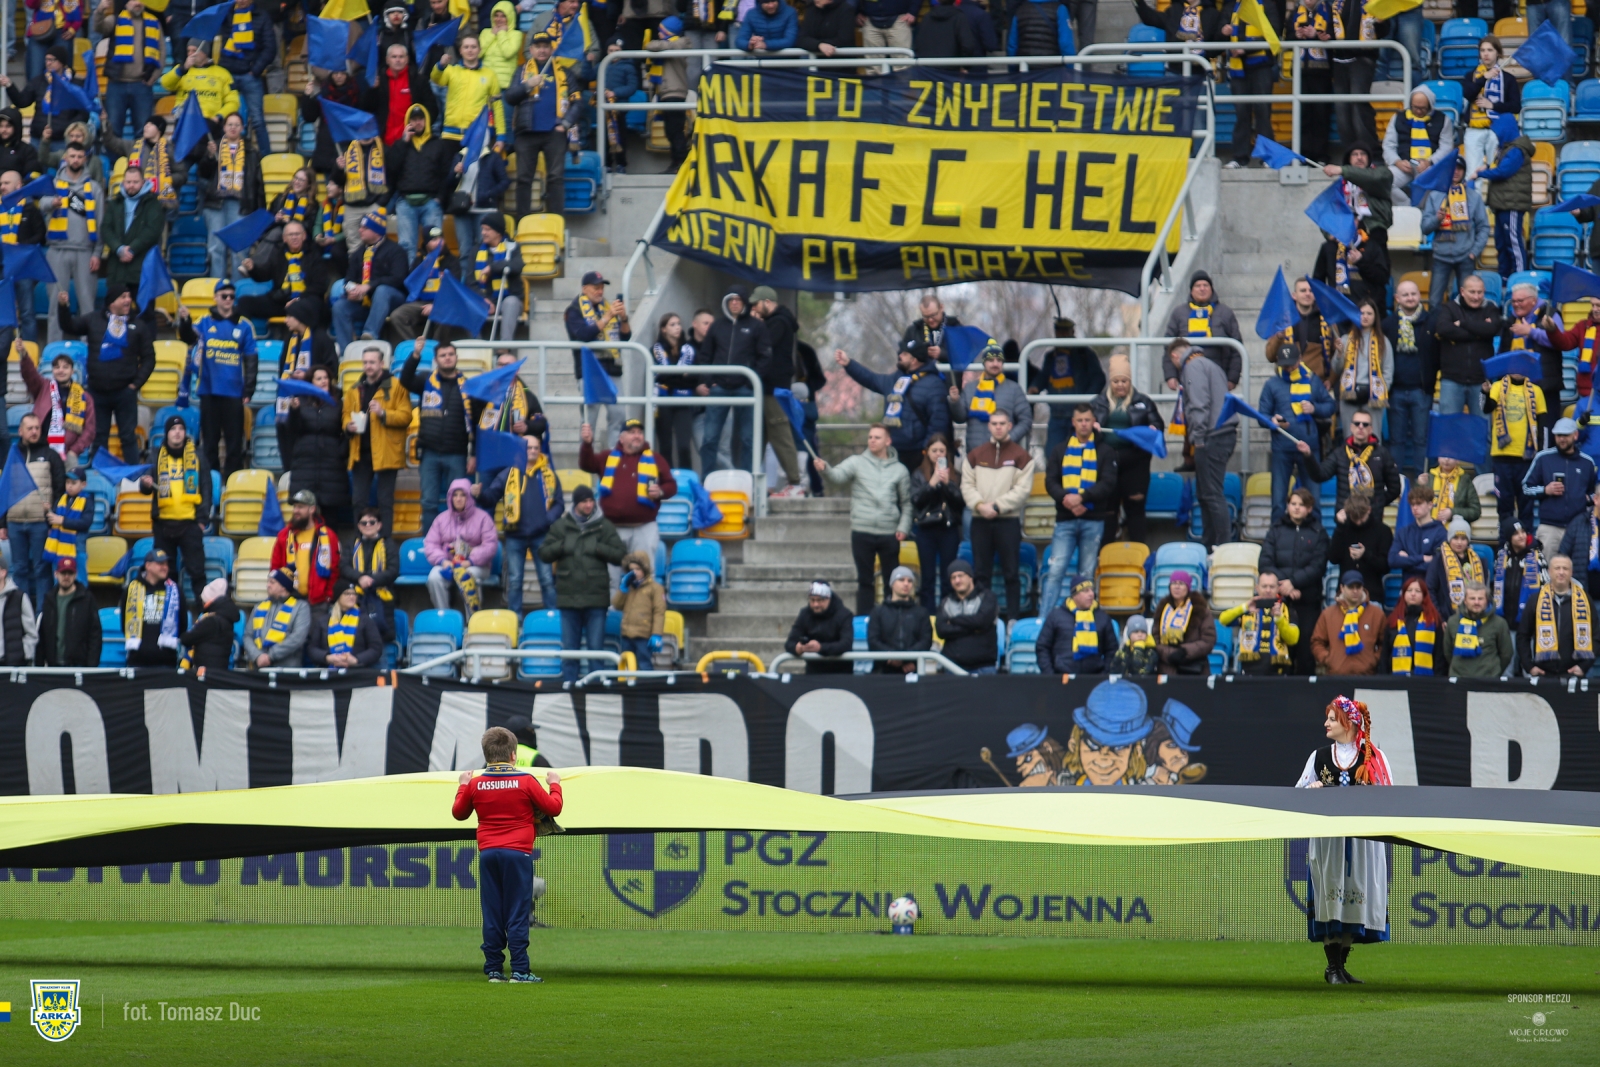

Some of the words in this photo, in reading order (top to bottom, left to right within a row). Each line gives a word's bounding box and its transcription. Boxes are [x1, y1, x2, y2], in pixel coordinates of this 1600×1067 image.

[697, 74, 761, 118] MNI
[806, 76, 863, 118] PO
[907, 80, 1180, 132] ZWYCIĘSTWIE
[1023, 150, 1156, 234] HEL
[667, 210, 776, 273] WIERNI
[802, 238, 858, 281] PO
[900, 245, 1092, 281] PORAŻCE
[477, 780, 519, 790] CASSUBIAN
[240, 846, 542, 889] MORSK
[724, 831, 828, 867] PGZ
